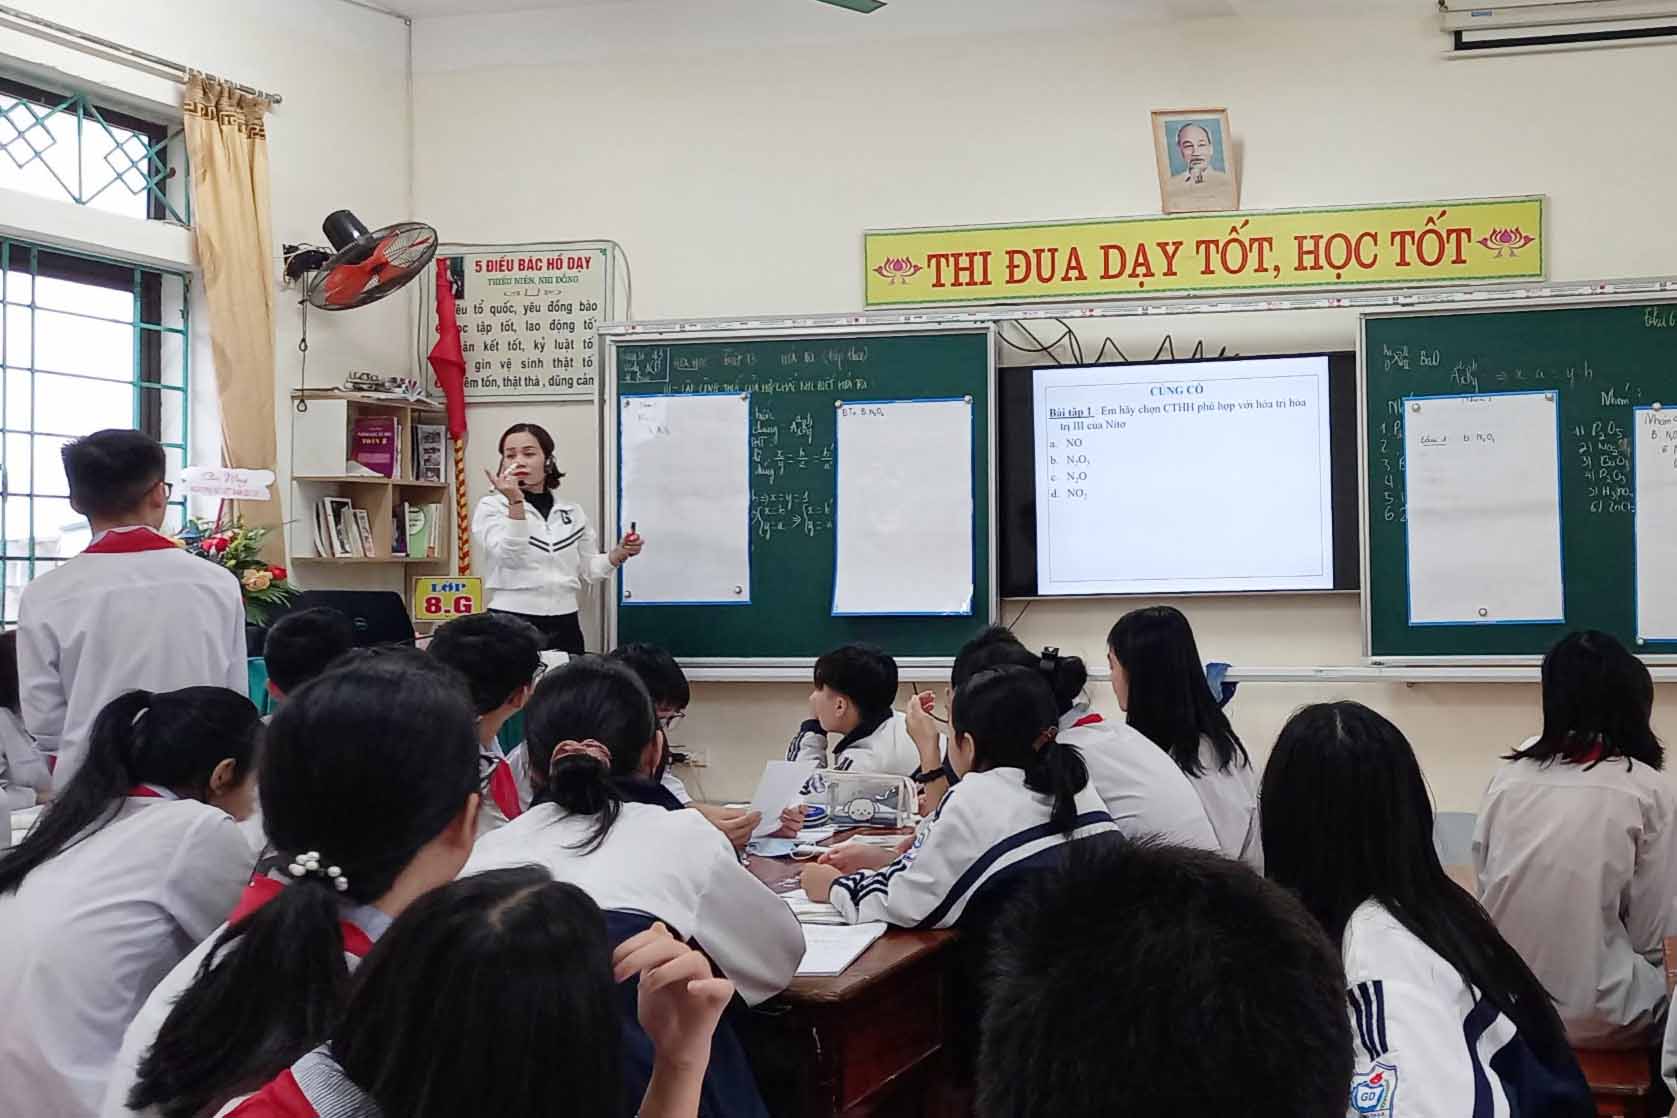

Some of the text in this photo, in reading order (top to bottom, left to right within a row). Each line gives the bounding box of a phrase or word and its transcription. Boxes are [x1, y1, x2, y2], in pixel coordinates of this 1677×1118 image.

[927, 209, 1472, 288] THI ĐUA DẠY TỐT, HỌC TỐT
[475, 260, 483, 272] 5
[518, 256, 543, 271] BÁC
[567, 256, 592, 272] DẠY
[456, 303, 468, 315] êu
[490, 300, 517, 317] quốc,
[523, 302, 541, 315] yêu
[477, 321, 493, 335] tập
[500, 318, 517, 333] tốt,
[525, 319, 541, 332] lao
[549, 319, 575, 333] động
[484, 338, 499, 352] kết
[507, 337, 525, 352] tốt,
[534, 336, 546, 352] kỷ
[554, 339, 574, 353] luật
[500, 358, 511, 372] vệ
[521, 358, 544, 369] sinh
[552, 357, 574, 371] thật
[503, 376, 522, 390] thật
[548, 375, 573, 388] dũng
[1101, 407, 1117, 416] Em
[1119, 404, 1135, 416] hãy
[1138, 403, 1160, 416] chọn
[1066, 438, 1083, 447] NO
[432, 581, 466, 593] LỚP
[425, 596, 473, 615] 8.G
[1361, 1091, 1376, 1102] GD
